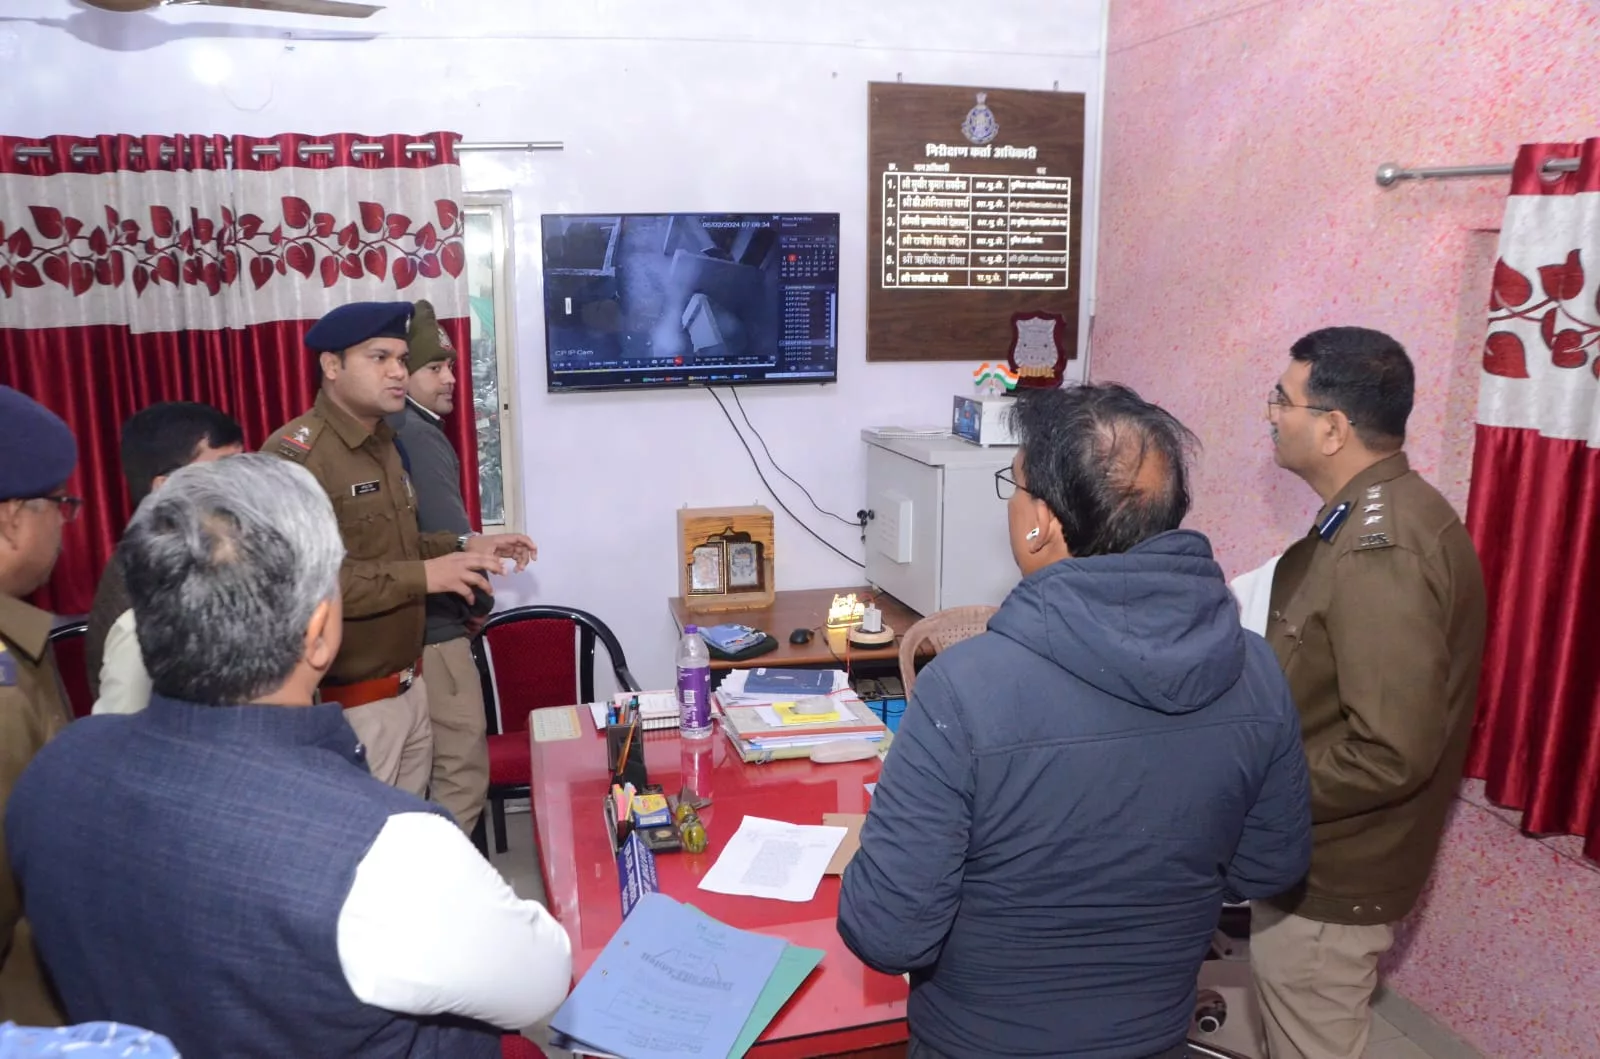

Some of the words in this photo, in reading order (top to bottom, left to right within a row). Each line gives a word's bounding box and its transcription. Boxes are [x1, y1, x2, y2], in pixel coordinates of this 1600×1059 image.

[925, 142, 968, 157] निरीक्षण
[970, 144, 992, 158] कर्ता
[993, 145, 1038, 160] अधिकारी
[887, 178, 896, 190] 1.
[886, 198, 896, 208] 2.
[886, 216, 896, 227] 3.
[886, 236, 895, 246] 4.
[902, 234, 912, 246] श्री
[886, 254, 895, 264] 5.
[902, 252, 913, 264] श्री
[886, 272, 895, 282] 6.
